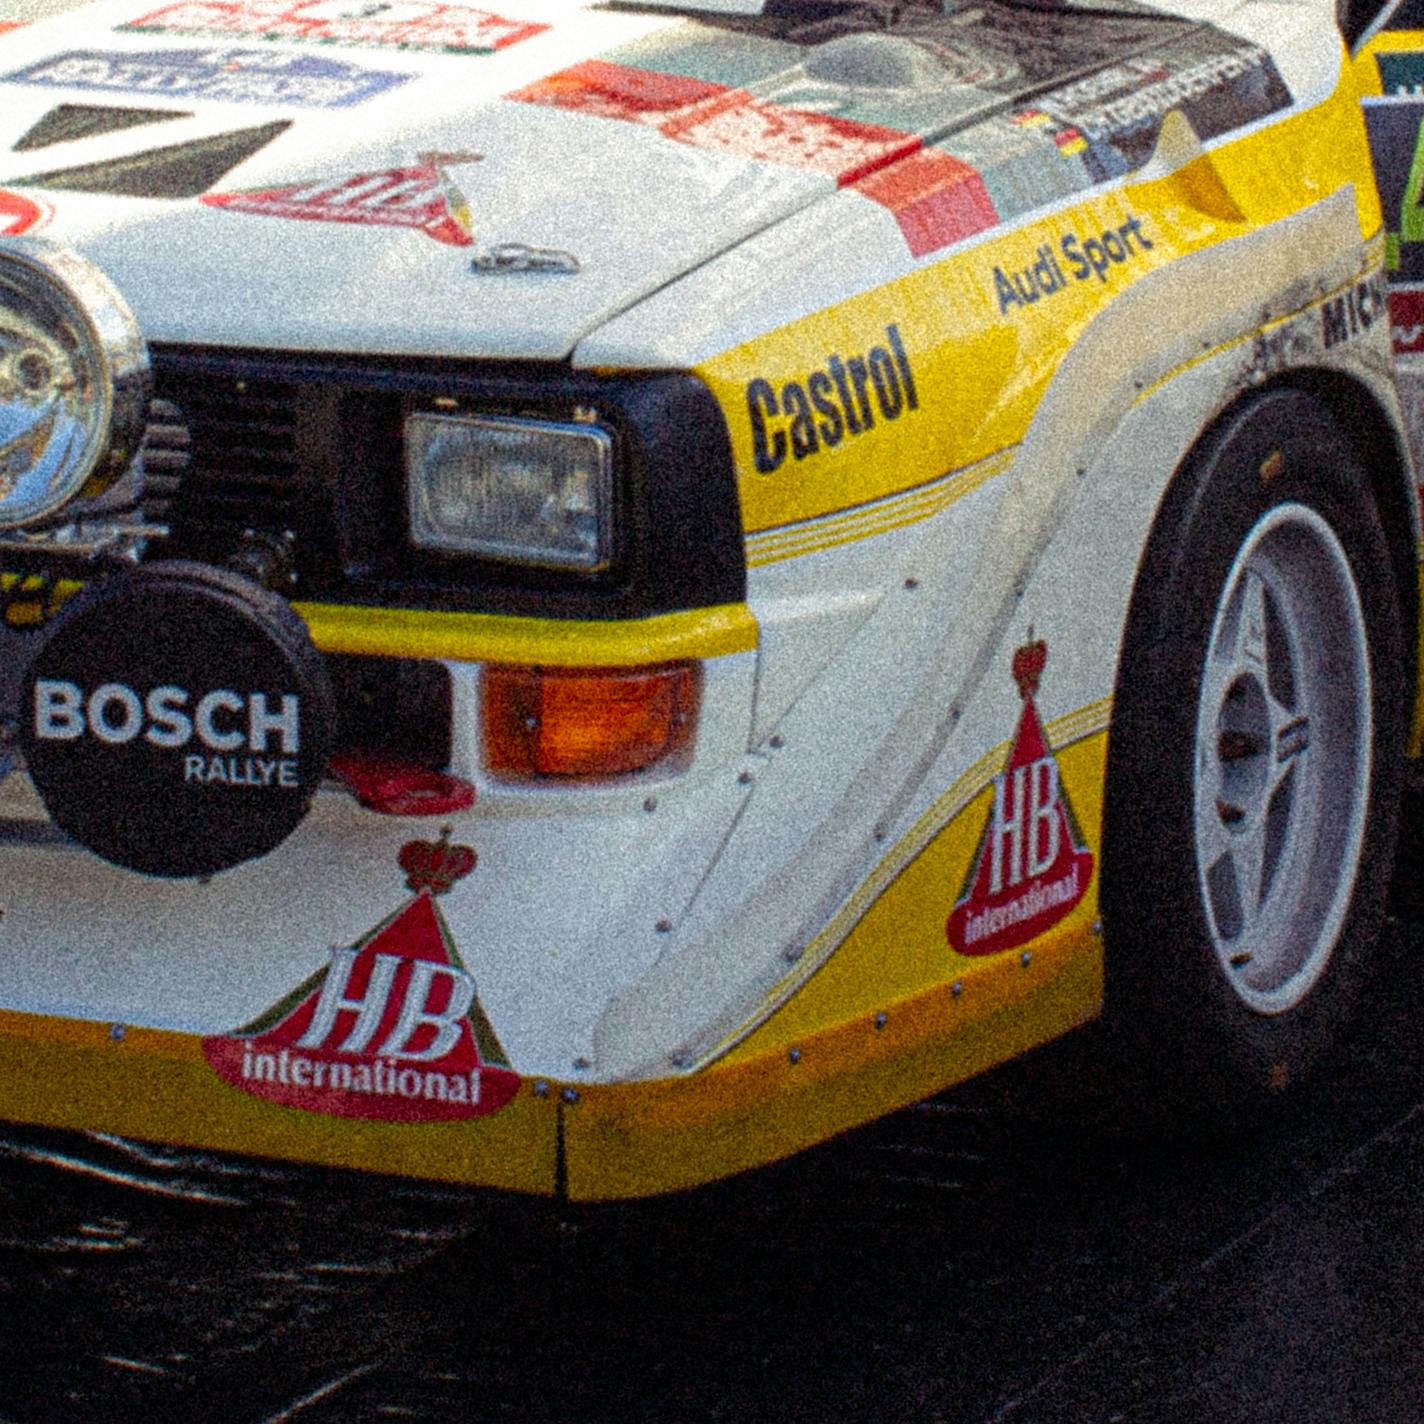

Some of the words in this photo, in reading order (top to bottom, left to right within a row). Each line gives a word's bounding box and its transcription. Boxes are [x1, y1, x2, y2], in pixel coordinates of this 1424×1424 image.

[992, 254, 1070, 314] Audi
[1067, 213, 1153, 281] Sport
[746, 323, 919, 475] Castrol
[35, 679, 299, 755] BOSCH
[185, 754, 299, 787] RALLYE
[988, 756, 1061, 897] HB
[296, 947, 475, 1062] HB
[242, 1042, 481, 1105] international
